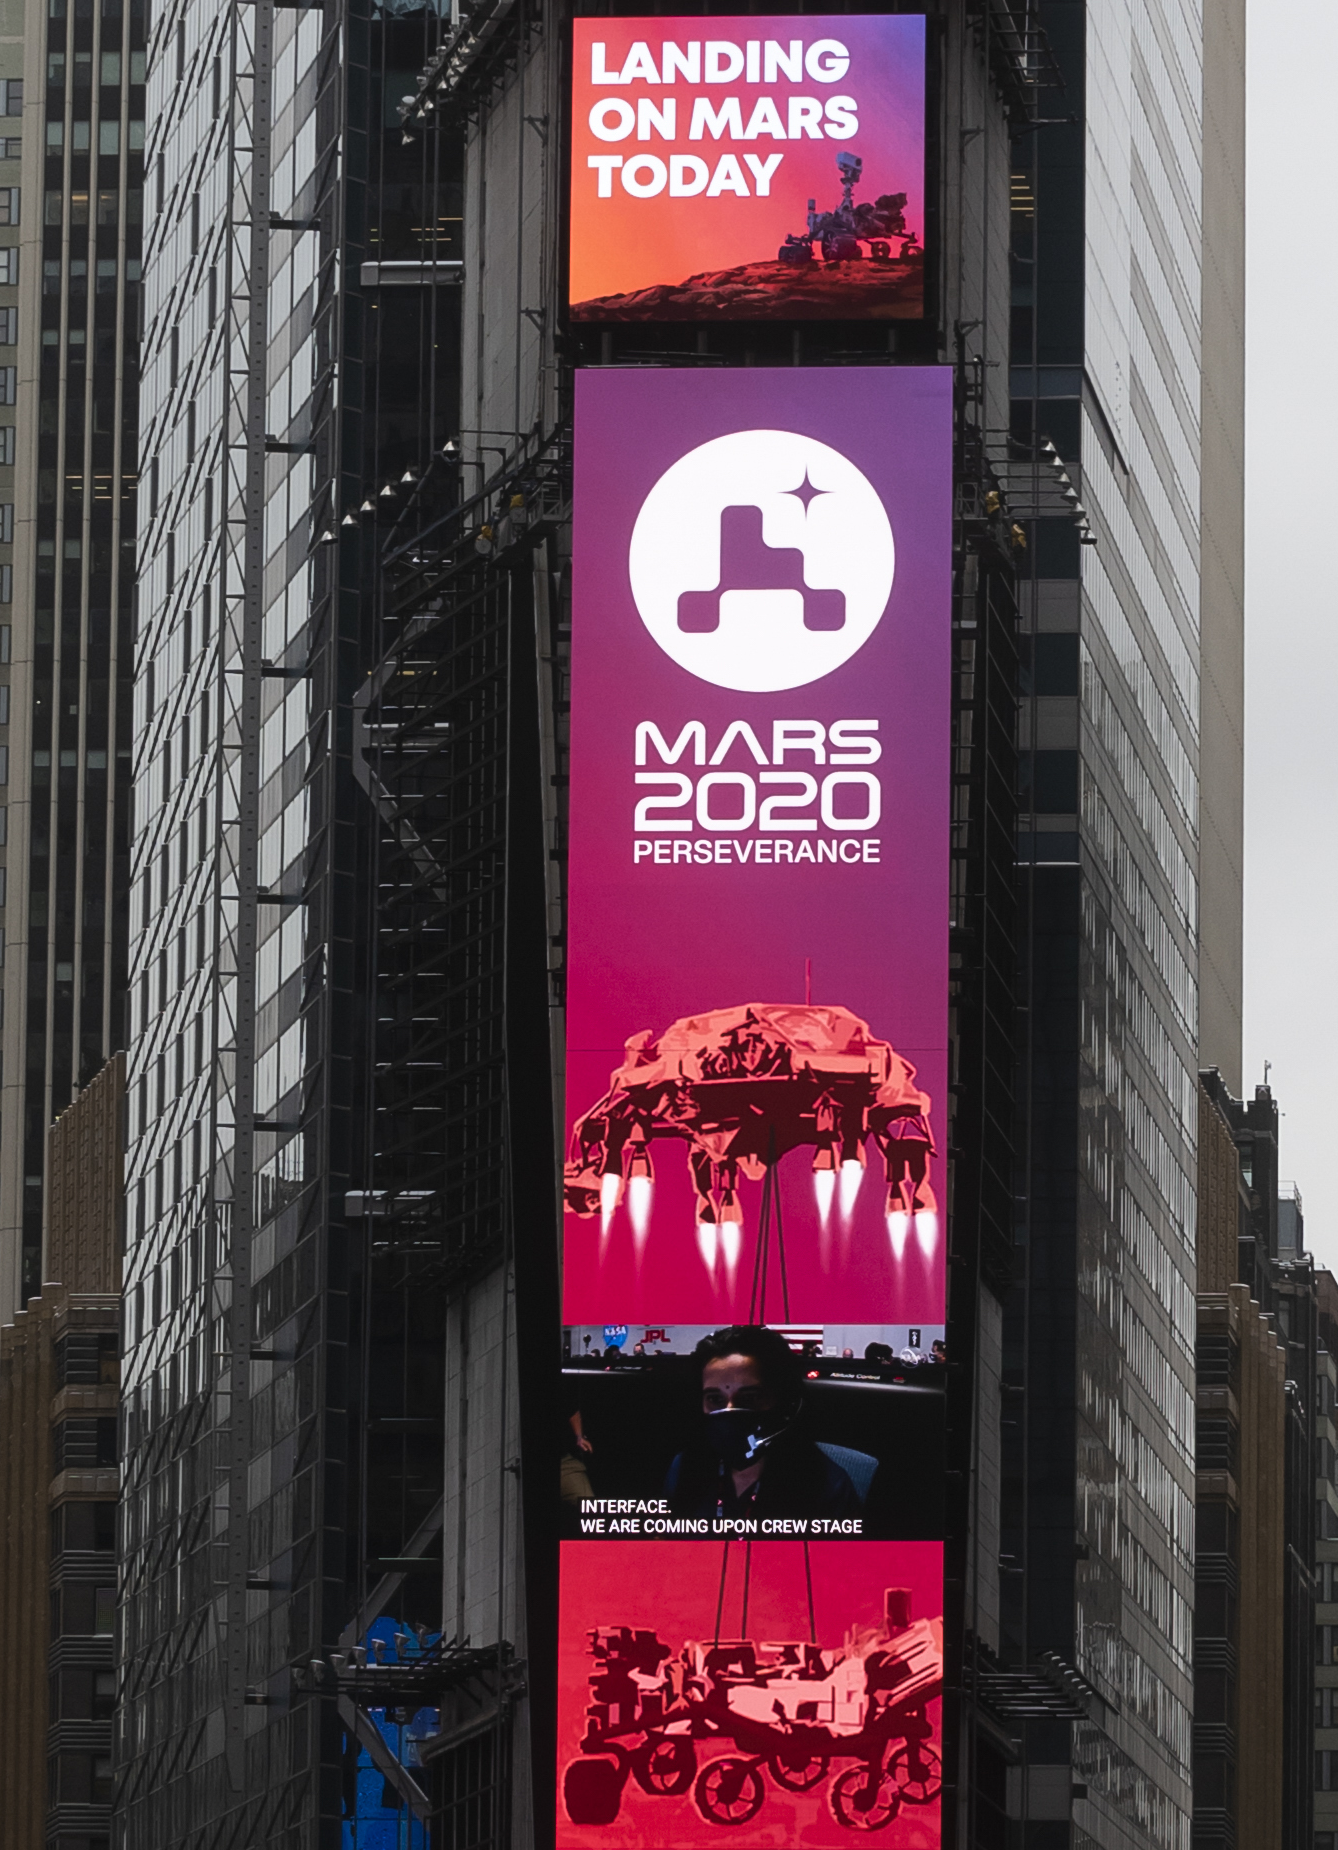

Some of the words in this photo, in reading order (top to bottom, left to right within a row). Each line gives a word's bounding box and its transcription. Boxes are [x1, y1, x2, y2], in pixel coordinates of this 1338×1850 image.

[591, 40, 850, 85] LANDING
[588, 97, 678, 141] ON
[689, 95, 859, 141] MARS
[587, 153, 784, 199] TODAY
[634, 719, 880, 766] MARS
[634, 770, 881, 832] 2020
[633, 838, 881, 864] PERSEVERANCE
[640, 1328, 671, 1344] JPL
[580, 1498, 672, 1514] INTERFACE.
[580, 1519, 607, 1534] WE
[608, 1519, 640, 1534] ARE
[643, 1519, 709, 1534] COMING
[712, 1519, 758, 1534] UPON
[761, 1519, 808, 1534] CREW
[810, 1519, 863, 1534] STAGE
